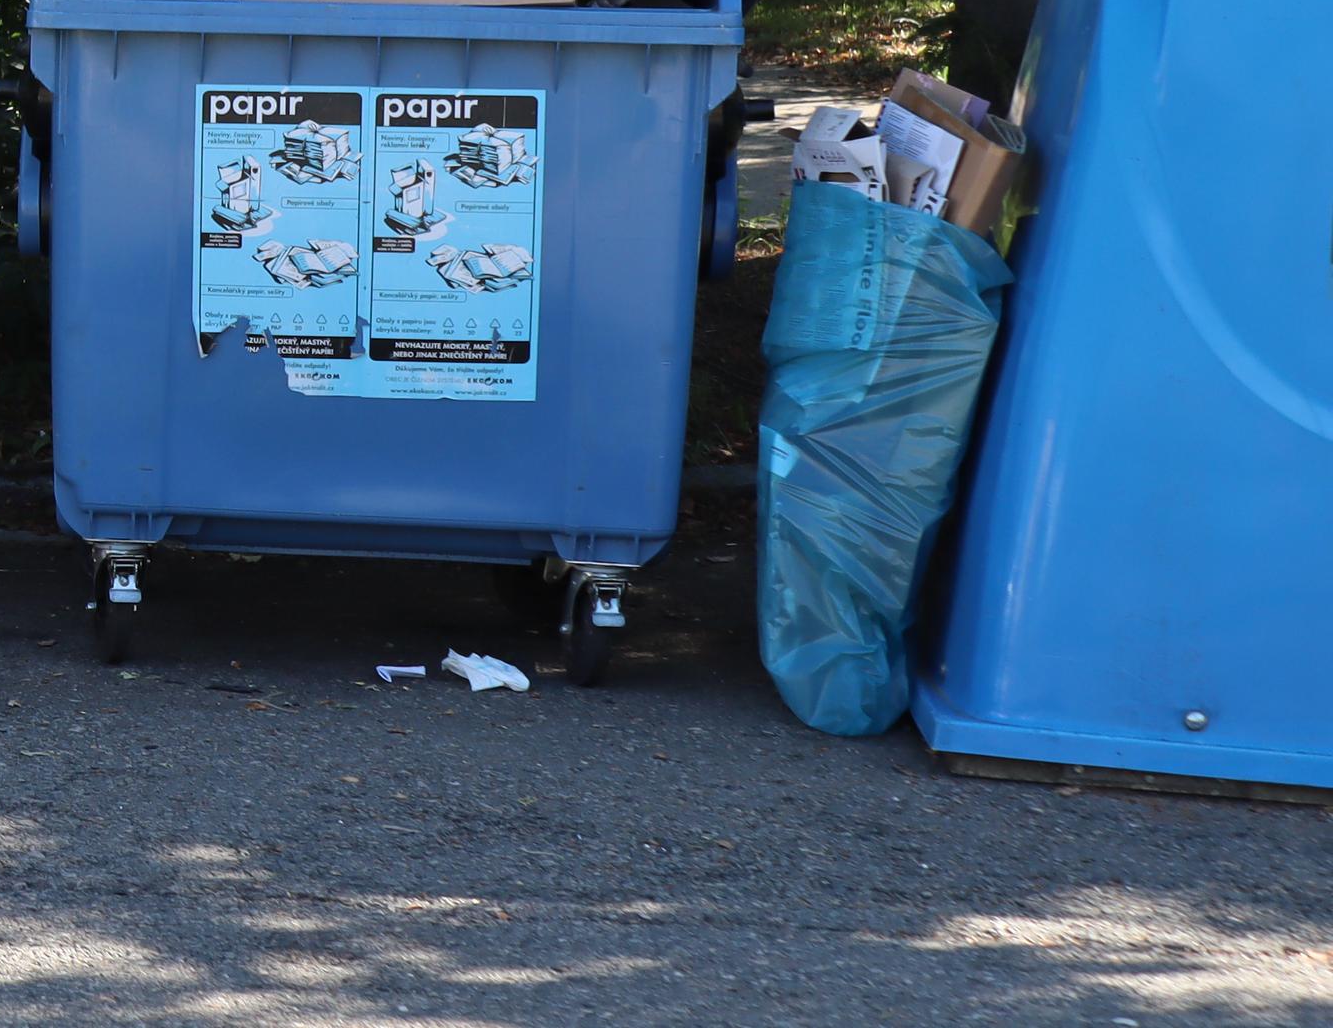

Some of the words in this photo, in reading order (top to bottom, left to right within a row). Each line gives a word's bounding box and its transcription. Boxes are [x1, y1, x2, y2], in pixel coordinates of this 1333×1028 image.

[210, 86, 303, 123] papír
[383, 90, 478, 127] papír
[300, 337, 332, 347] MASTNÝ,
[395, 341, 441, 350] NEVHAZUJTE
[442, 341, 472, 351] MOKRÝ,
[415, 351, 437, 359] JINAK
[439, 351, 483, 359] ZNEČIŠTĚNÝ
